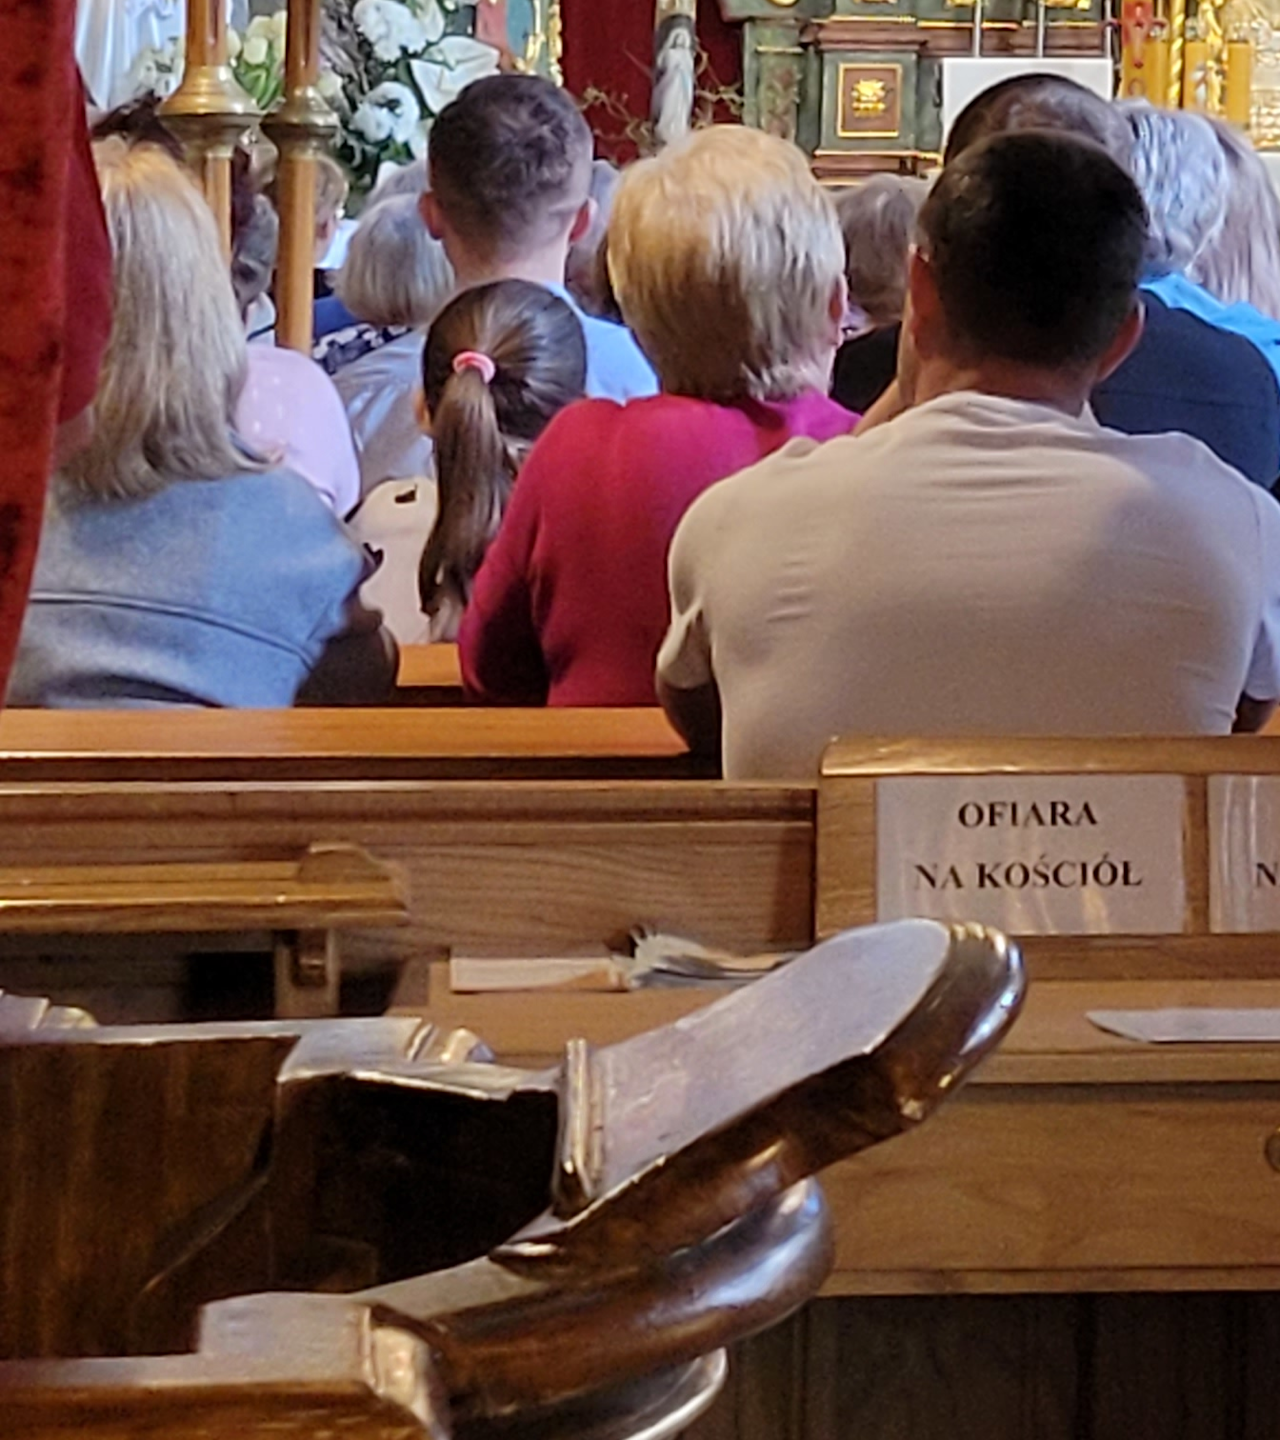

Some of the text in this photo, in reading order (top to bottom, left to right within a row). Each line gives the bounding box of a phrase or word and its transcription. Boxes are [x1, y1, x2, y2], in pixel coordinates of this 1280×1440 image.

[957, 800, 1098, 829] OFIARA
[913, 851, 1143, 890] NA KOŚCIÓŁ
